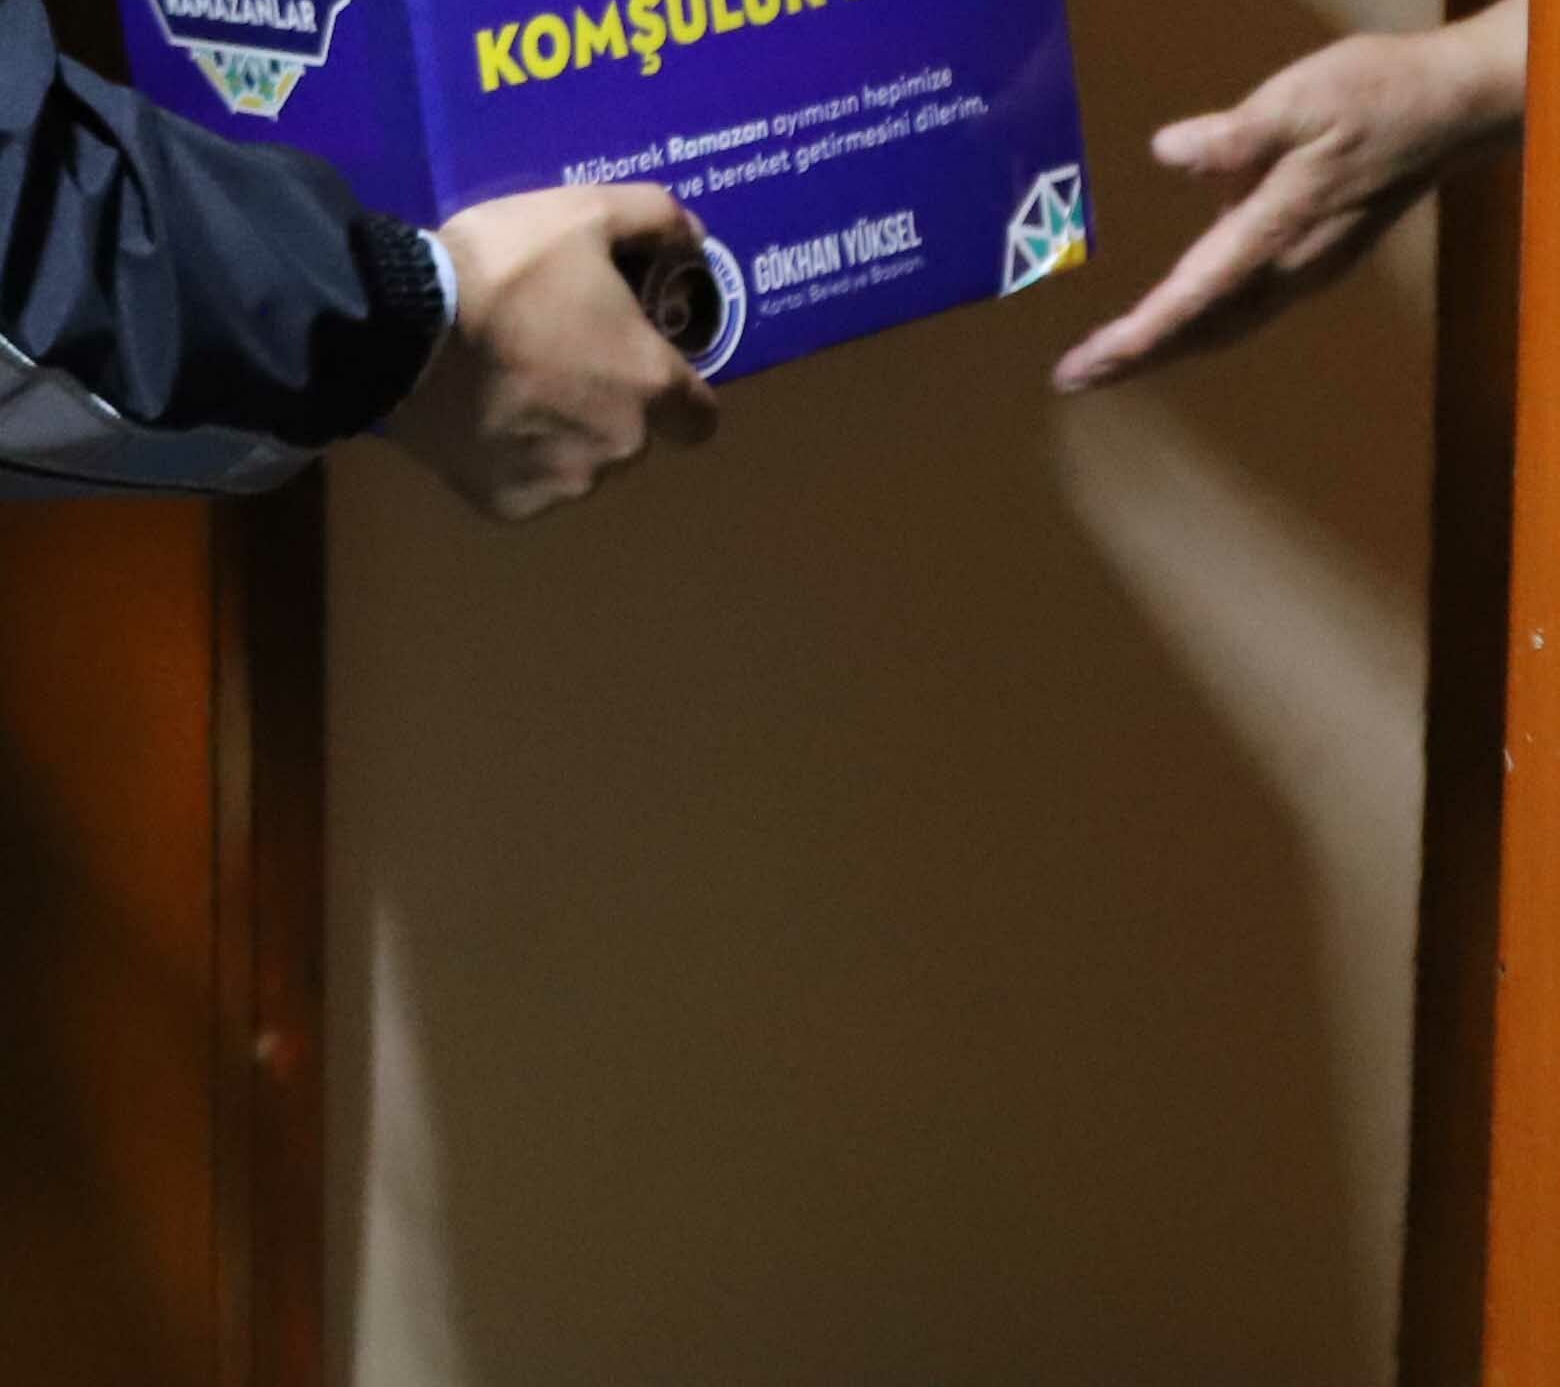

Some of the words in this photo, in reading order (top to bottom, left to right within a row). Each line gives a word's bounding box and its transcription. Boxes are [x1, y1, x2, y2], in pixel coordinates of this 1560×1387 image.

[562, 142, 665, 188] Mübarek
[667, 119, 769, 164] Ramazan
[773, 94, 860, 140] ayımızın
[862, 64, 953, 109] hepimize
[679, 174, 704, 200] ve
[709, 149, 792, 192] bereket
[795, 111, 911, 174] getirmesini
[753, 233, 841, 295] GÖKHAN
[842, 210, 923, 268] YÜKSEL
